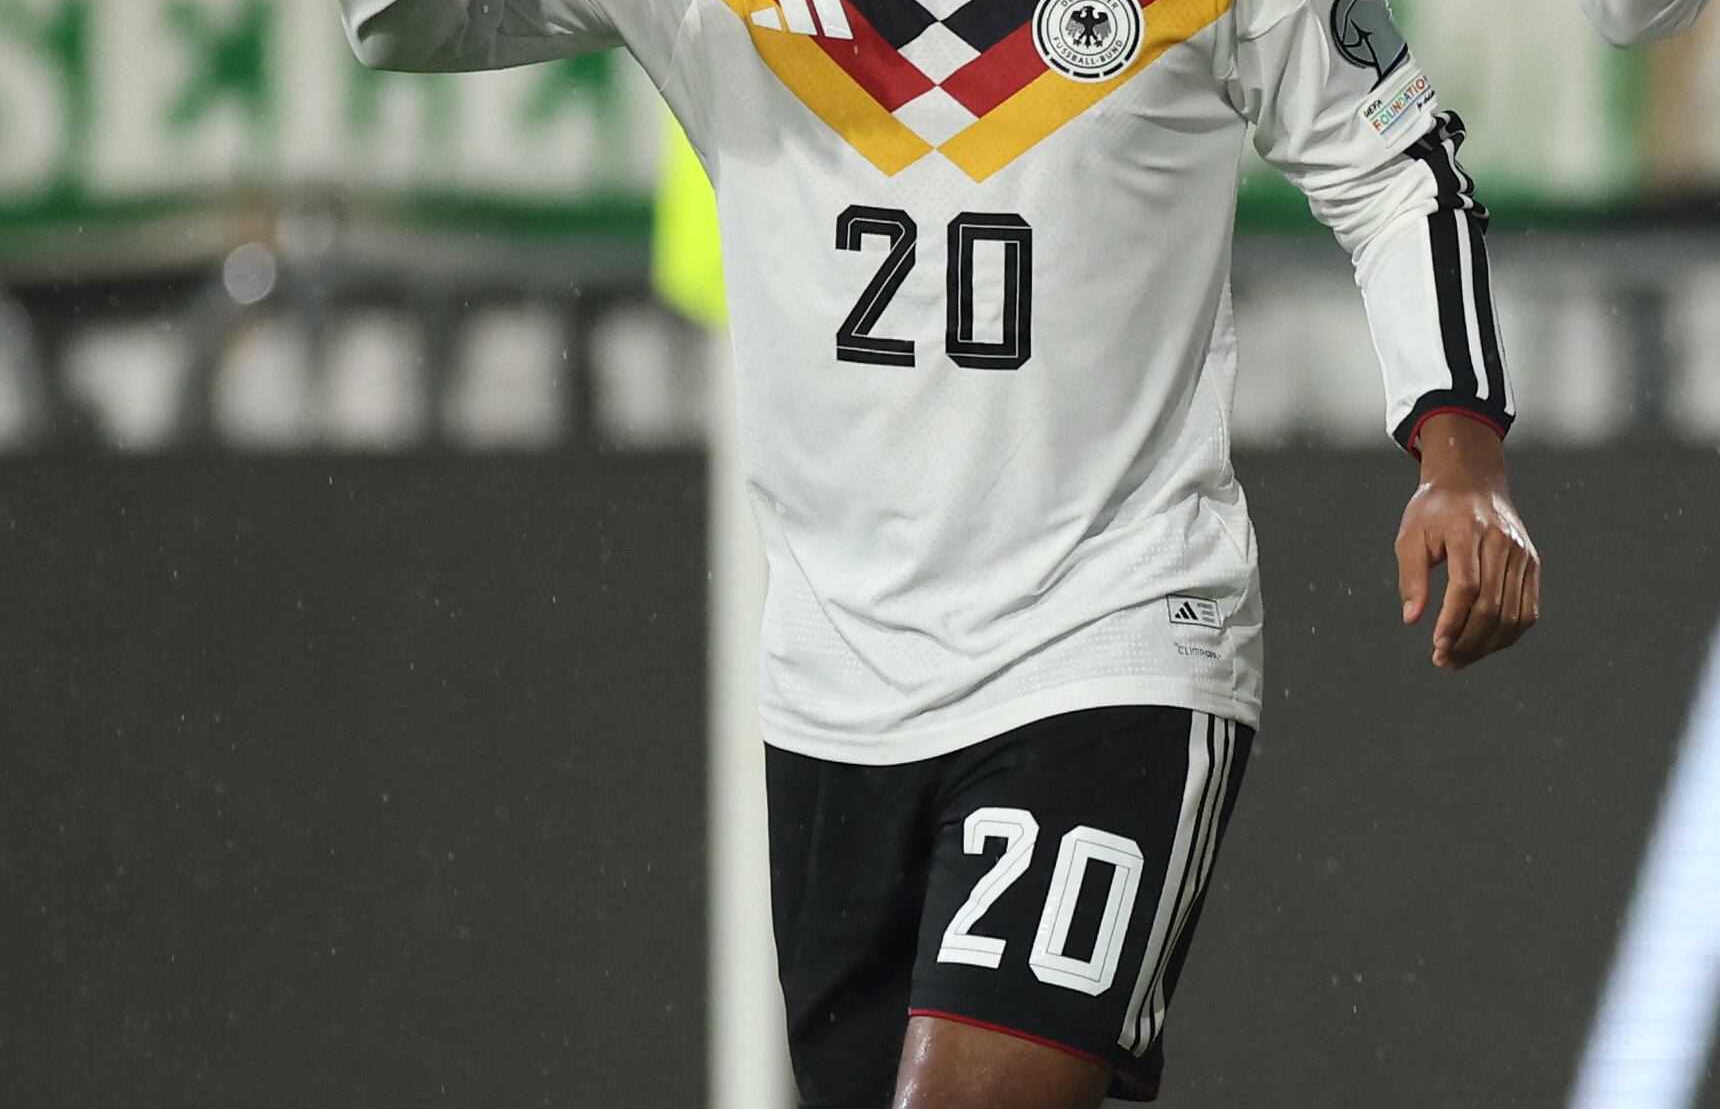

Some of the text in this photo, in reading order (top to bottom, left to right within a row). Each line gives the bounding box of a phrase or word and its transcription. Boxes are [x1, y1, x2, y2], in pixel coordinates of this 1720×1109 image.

[1052, 35, 1124, 65] FUSSBALL-BUND
[1364, 99, 1382, 118] UEFA
[835, 204, 1033, 371] 20
[936, 806, 1145, 997] 20
